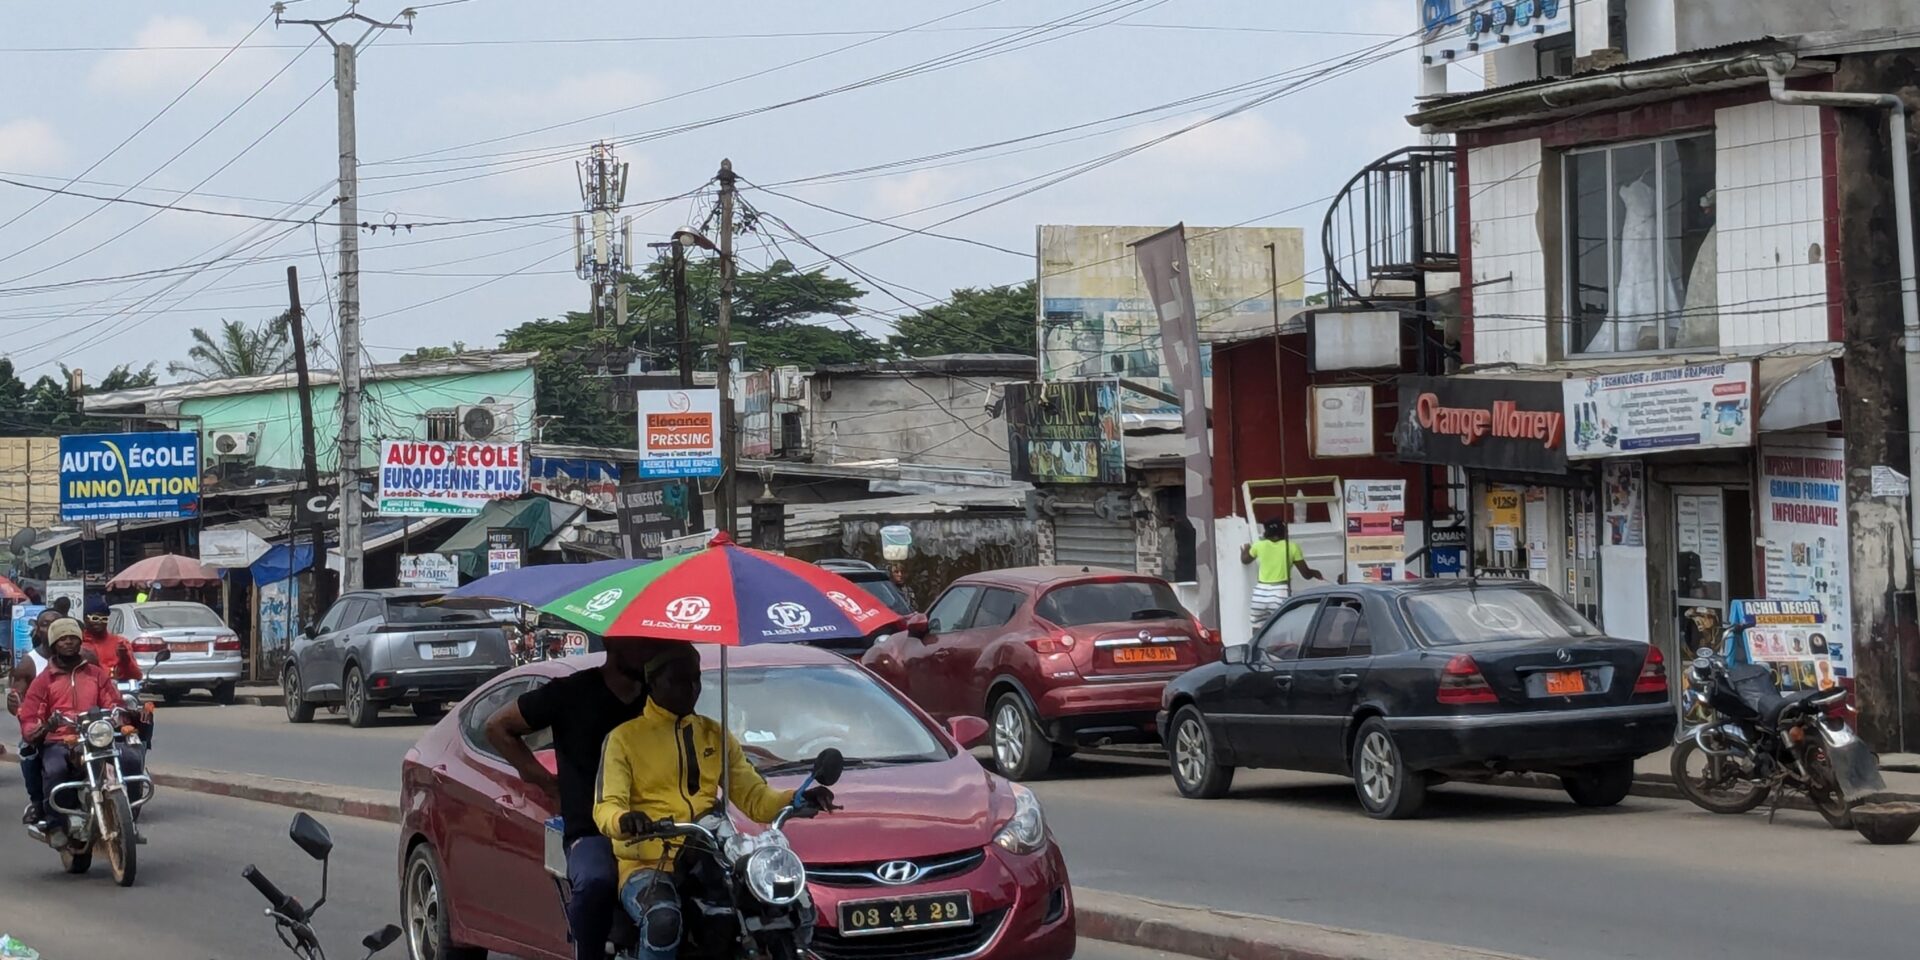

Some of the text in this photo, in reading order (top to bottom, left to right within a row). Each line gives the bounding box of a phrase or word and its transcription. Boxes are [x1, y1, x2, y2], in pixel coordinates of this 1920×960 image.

[1417, 392, 1491, 445] Orange
[1492, 400, 1561, 448] Money
[650, 433, 710, 446] PRESSING
[61, 443, 196, 473] AUTO ÉCOLE
[384, 468, 521, 491] EUROPEENNE PLUS
[1770, 479, 1839, 502] GRAND FORMAT
[1772, 502, 1838, 526] INFOGRAPHIE
[1744, 602, 1820, 615] ACHIL DECOR
[692, 624, 722, 632] MOTO
[851, 902, 958, 928] 03 44 29
